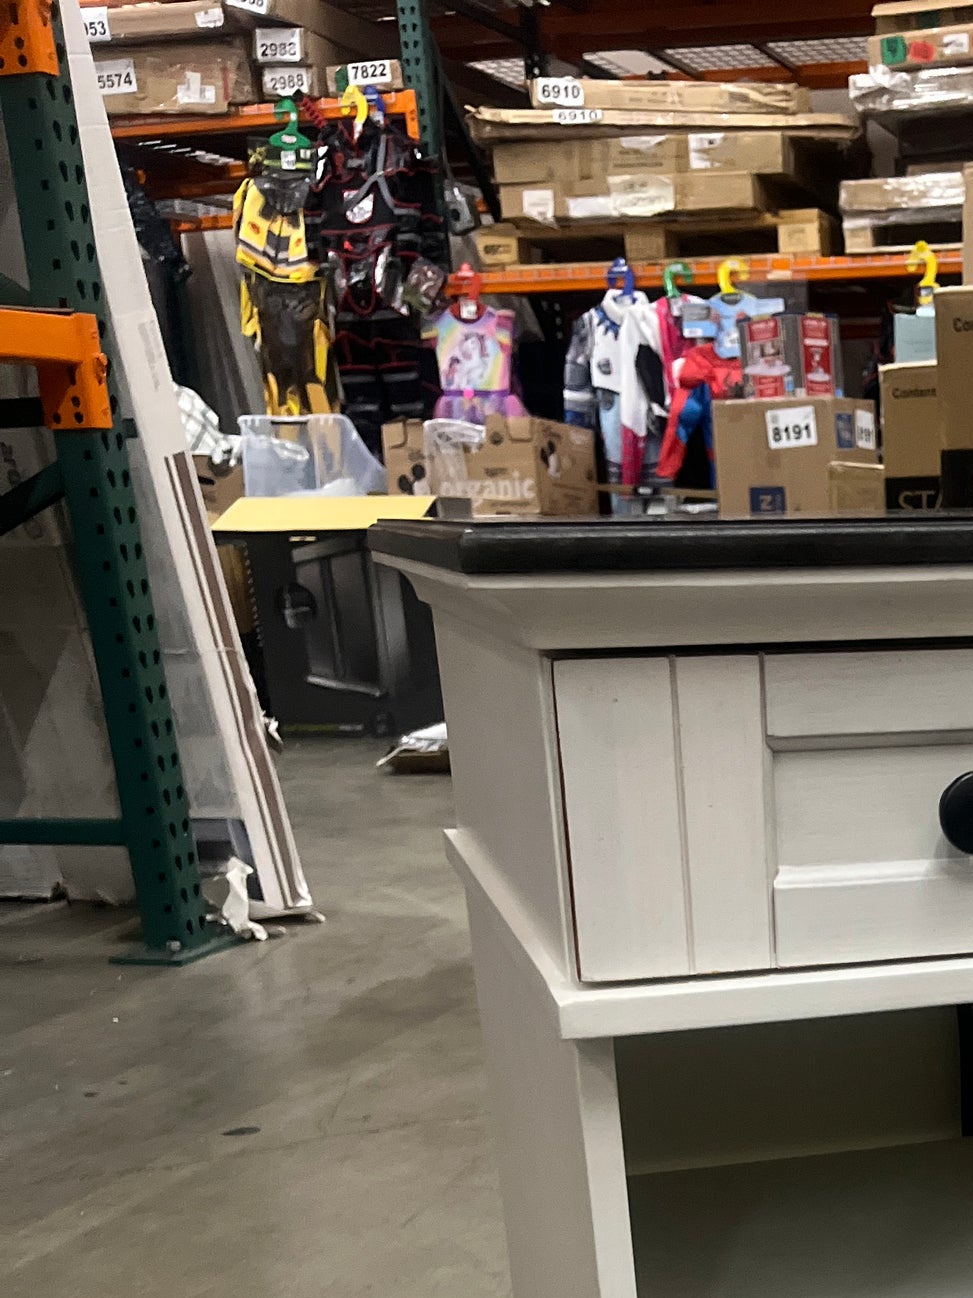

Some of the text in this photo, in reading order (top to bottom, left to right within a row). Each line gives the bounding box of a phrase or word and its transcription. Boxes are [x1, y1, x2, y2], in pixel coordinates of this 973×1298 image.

[351, 63, 387, 80] 7822
[97, 72, 133, 89] 5574
[270, 74, 305, 91] 2988
[541, 84, 581, 99] 6910
[558, 110, 599, 121] 6910
[772, 424, 812, 443] 8191
